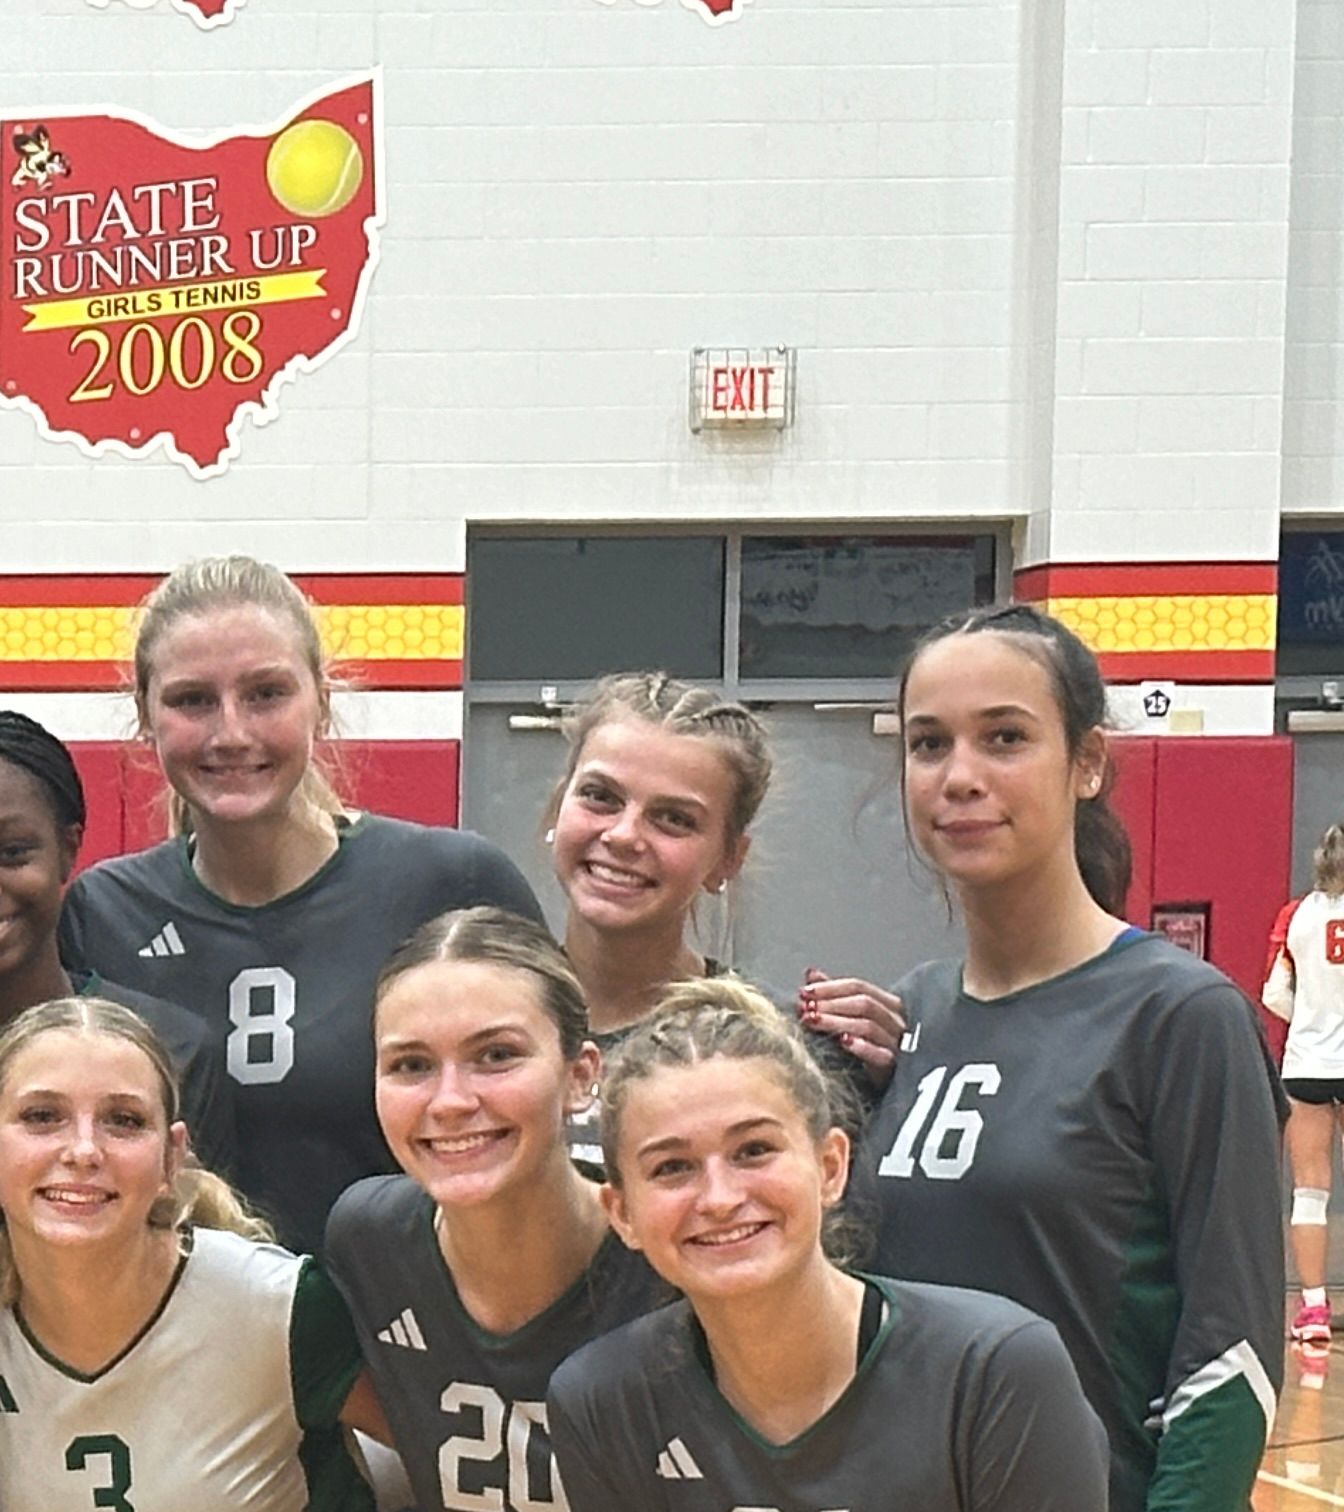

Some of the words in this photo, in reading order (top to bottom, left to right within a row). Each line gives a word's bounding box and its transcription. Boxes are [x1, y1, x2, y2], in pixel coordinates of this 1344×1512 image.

[16, 179, 220, 253] STATE
[14, 236, 235, 298] RUNNER
[251, 225, 316, 269] UP
[87, 294, 161, 320] GIRLS
[170, 282, 260, 308] TENNIS
[70, 311, 263, 402] 2008
[713, 367, 775, 413] EXIT
[1146, 695, 1168, 714] 25
[226, 966, 296, 1084] 8
[878, 1063, 1002, 1179] 16
